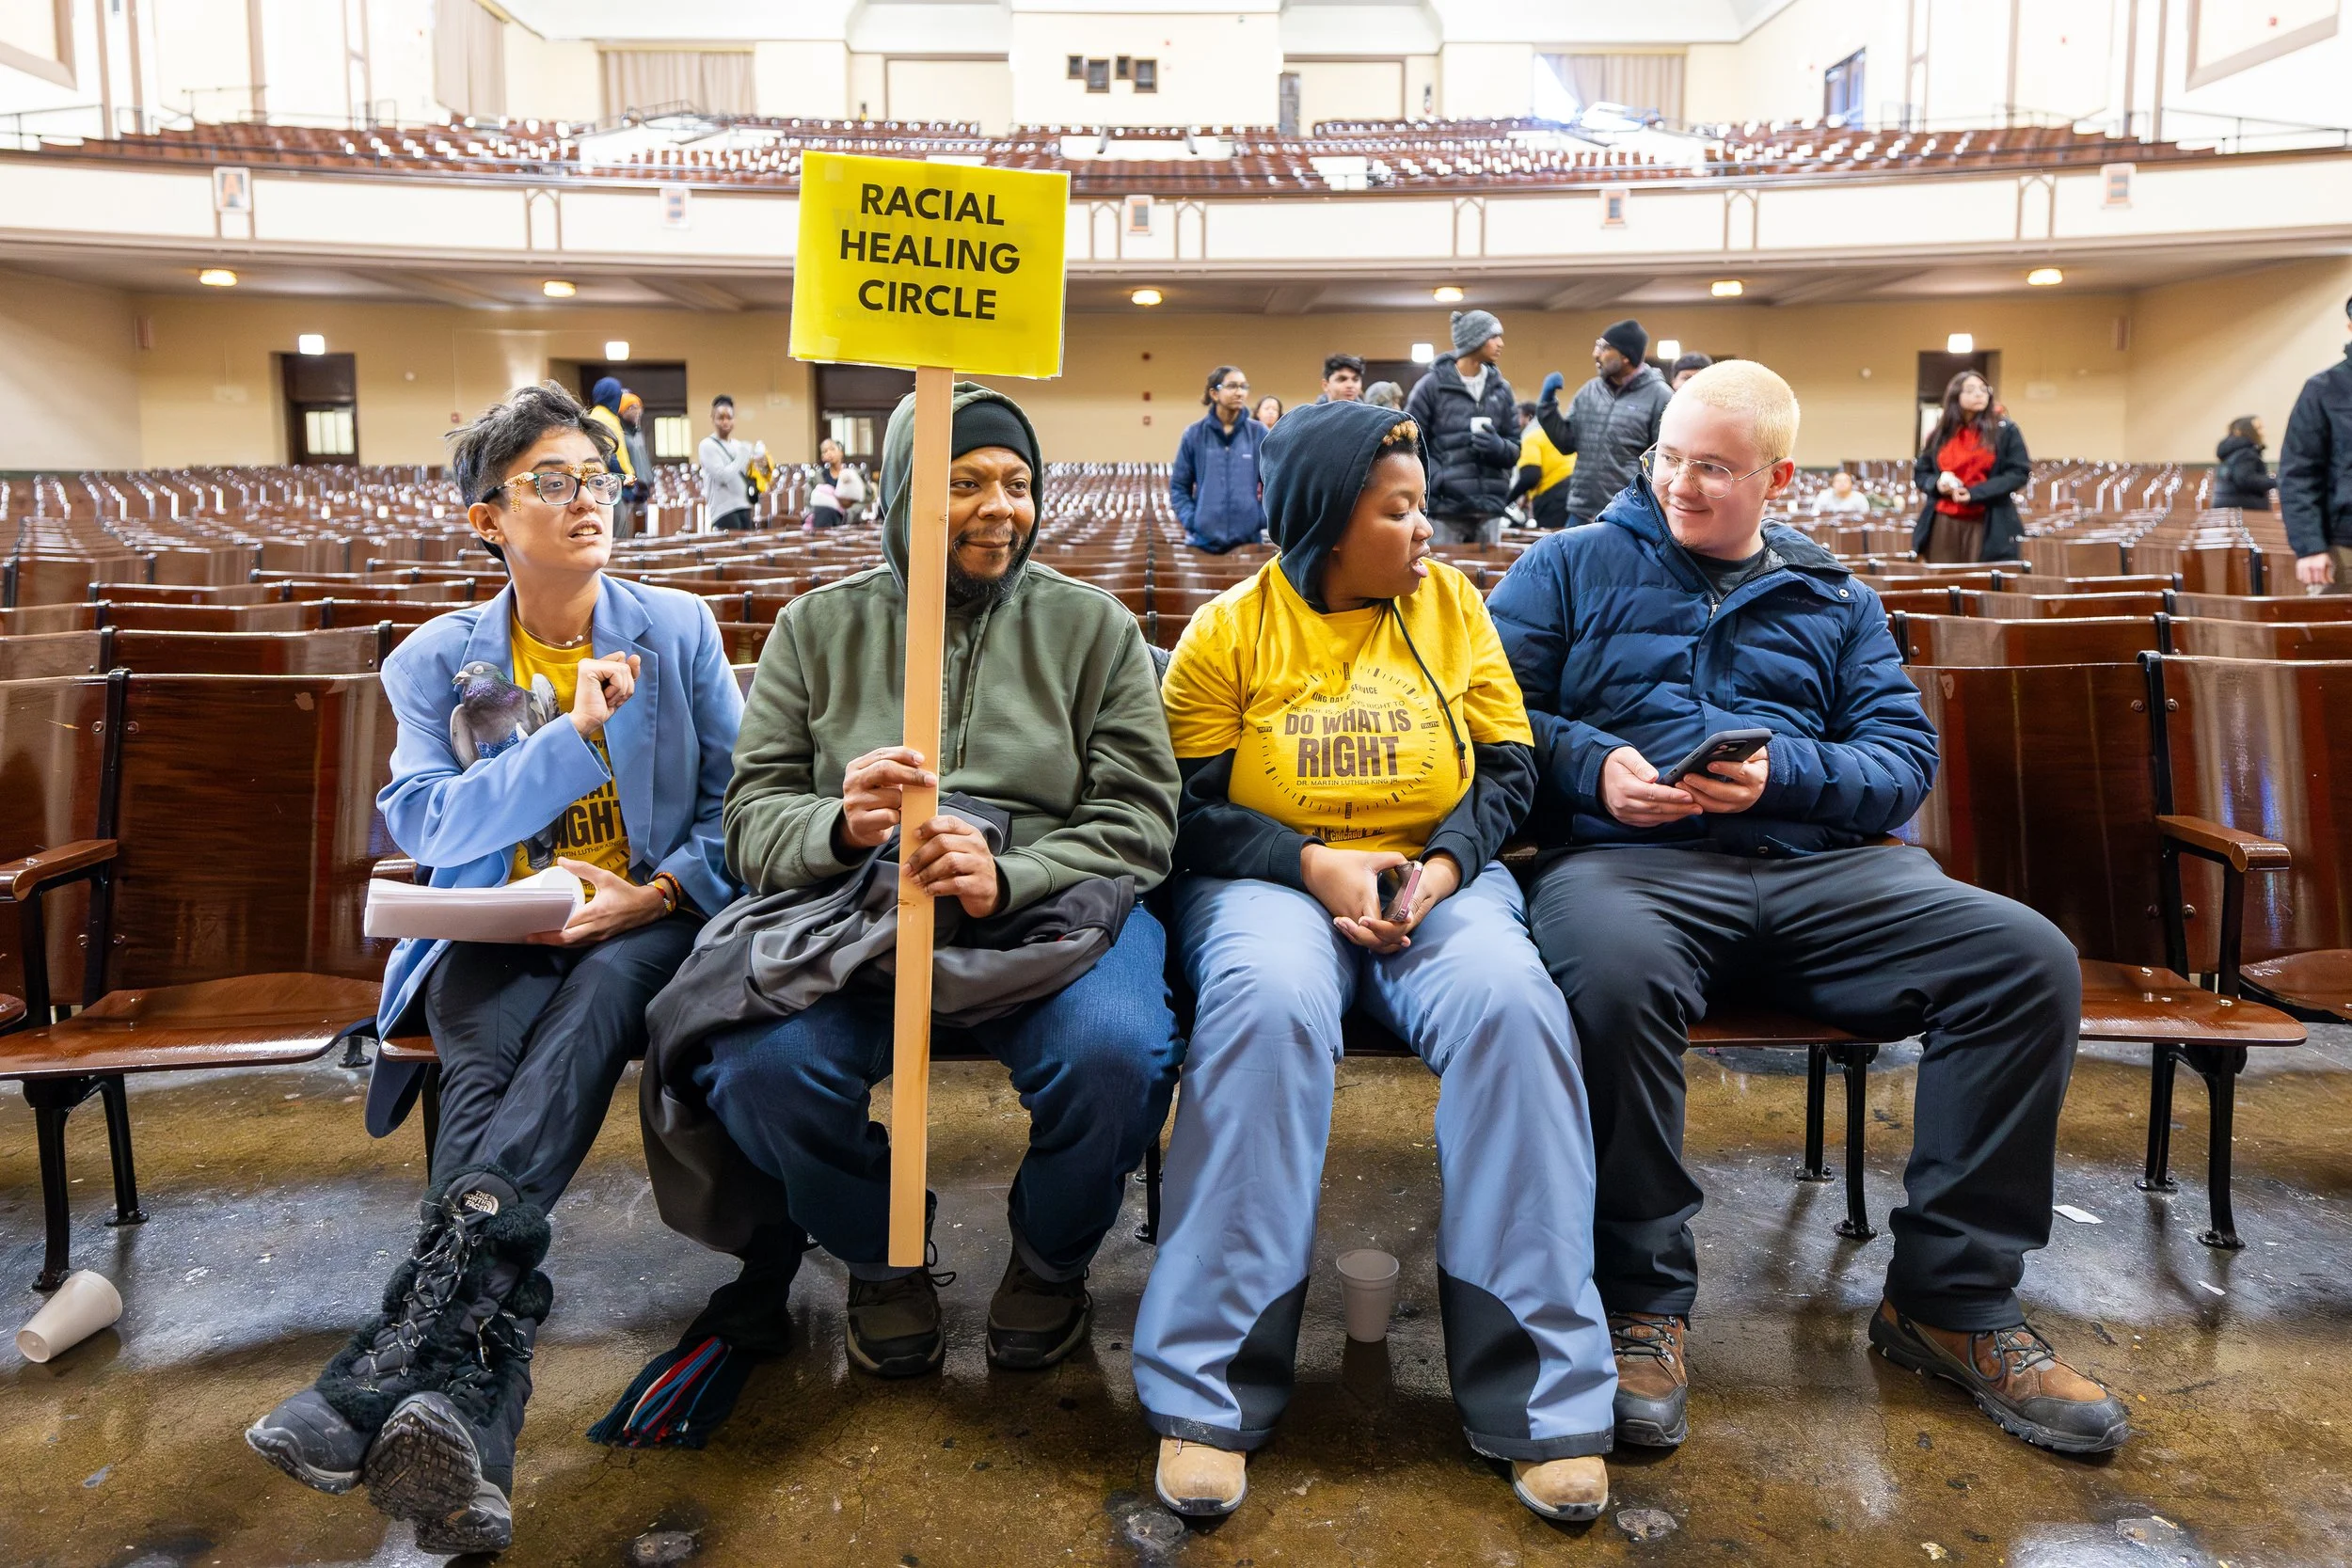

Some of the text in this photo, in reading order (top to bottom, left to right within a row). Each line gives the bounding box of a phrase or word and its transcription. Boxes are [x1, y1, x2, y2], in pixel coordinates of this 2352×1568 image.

[861, 182, 1005, 226] RACIAL
[840, 230, 1021, 275] HEALING
[858, 279, 996, 320] CIRCLE
[1289, 704, 1302, 713] THE
[1367, 701, 1391, 710] RIGHT
[1393, 700, 1406, 708] TO
[1285, 708, 1412, 736] DO WHAT IS
[1297, 736, 1400, 778] RIGHT
[1330, 829, 1362, 842] CHICAGO
[463, 1193, 487, 1206] NORTH
[475, 1190, 491, 1200] THE
[465, 1199, 485, 1212] FACE
